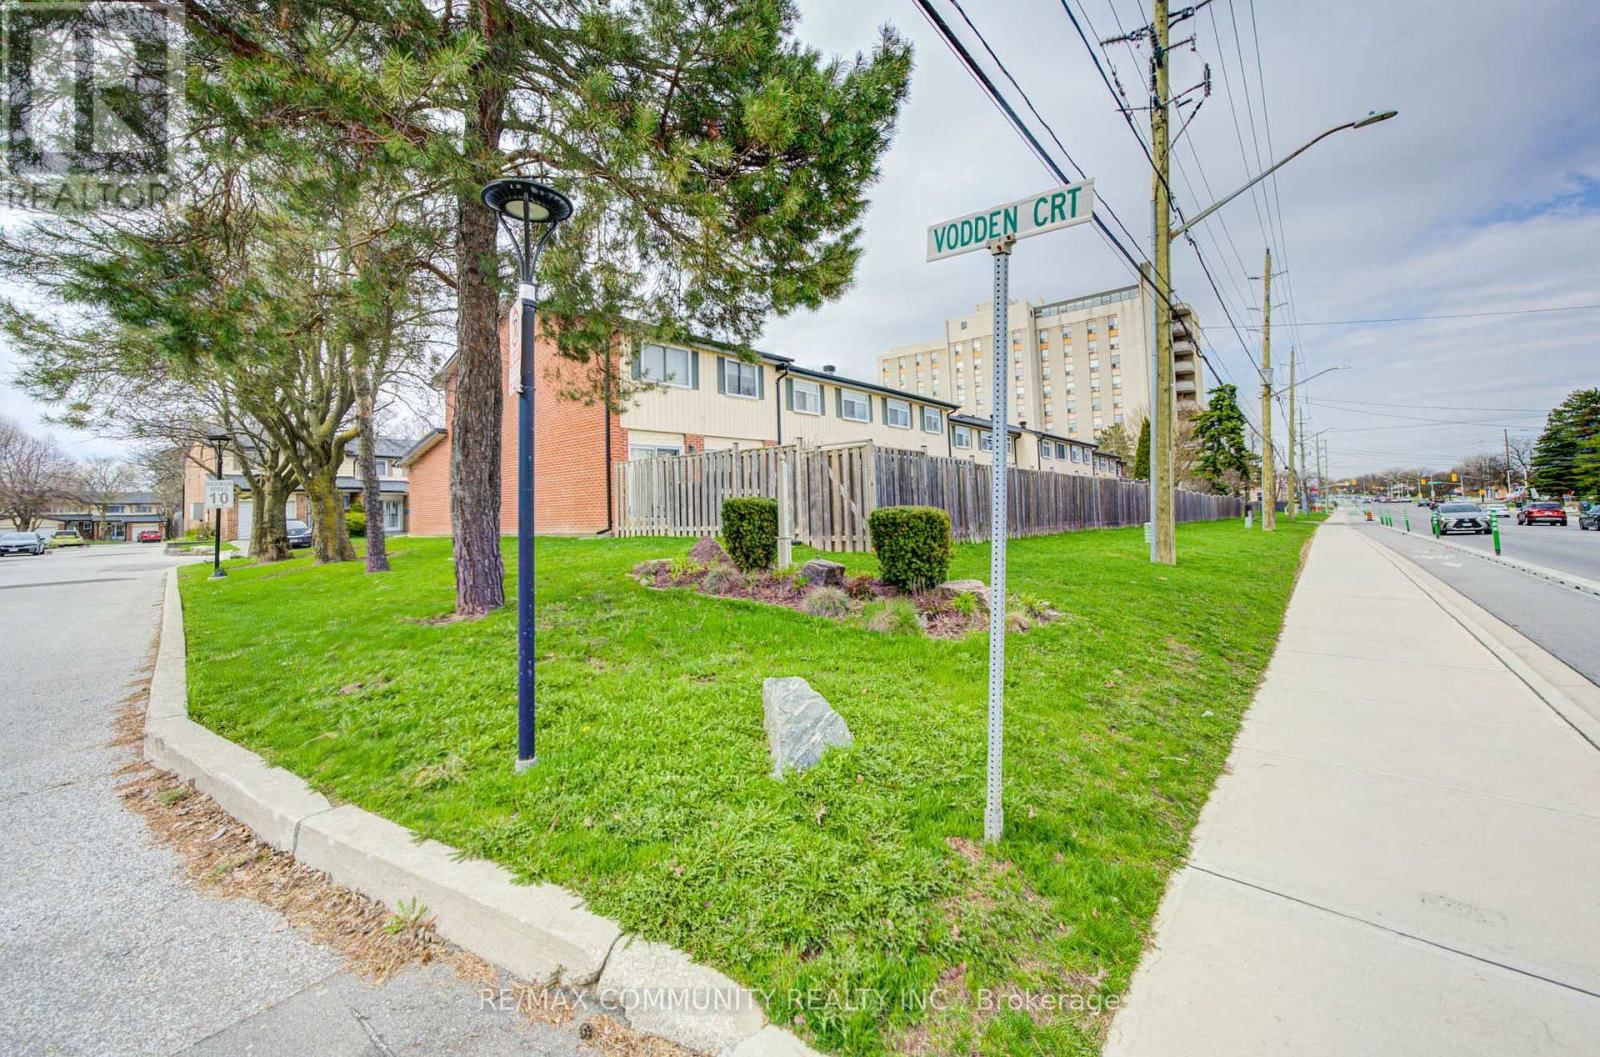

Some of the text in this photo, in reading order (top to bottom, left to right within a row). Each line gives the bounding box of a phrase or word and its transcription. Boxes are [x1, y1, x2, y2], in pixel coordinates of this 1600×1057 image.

[934, 186, 1082, 253] VODDEN CRT
[209, 492, 229, 504] 10
